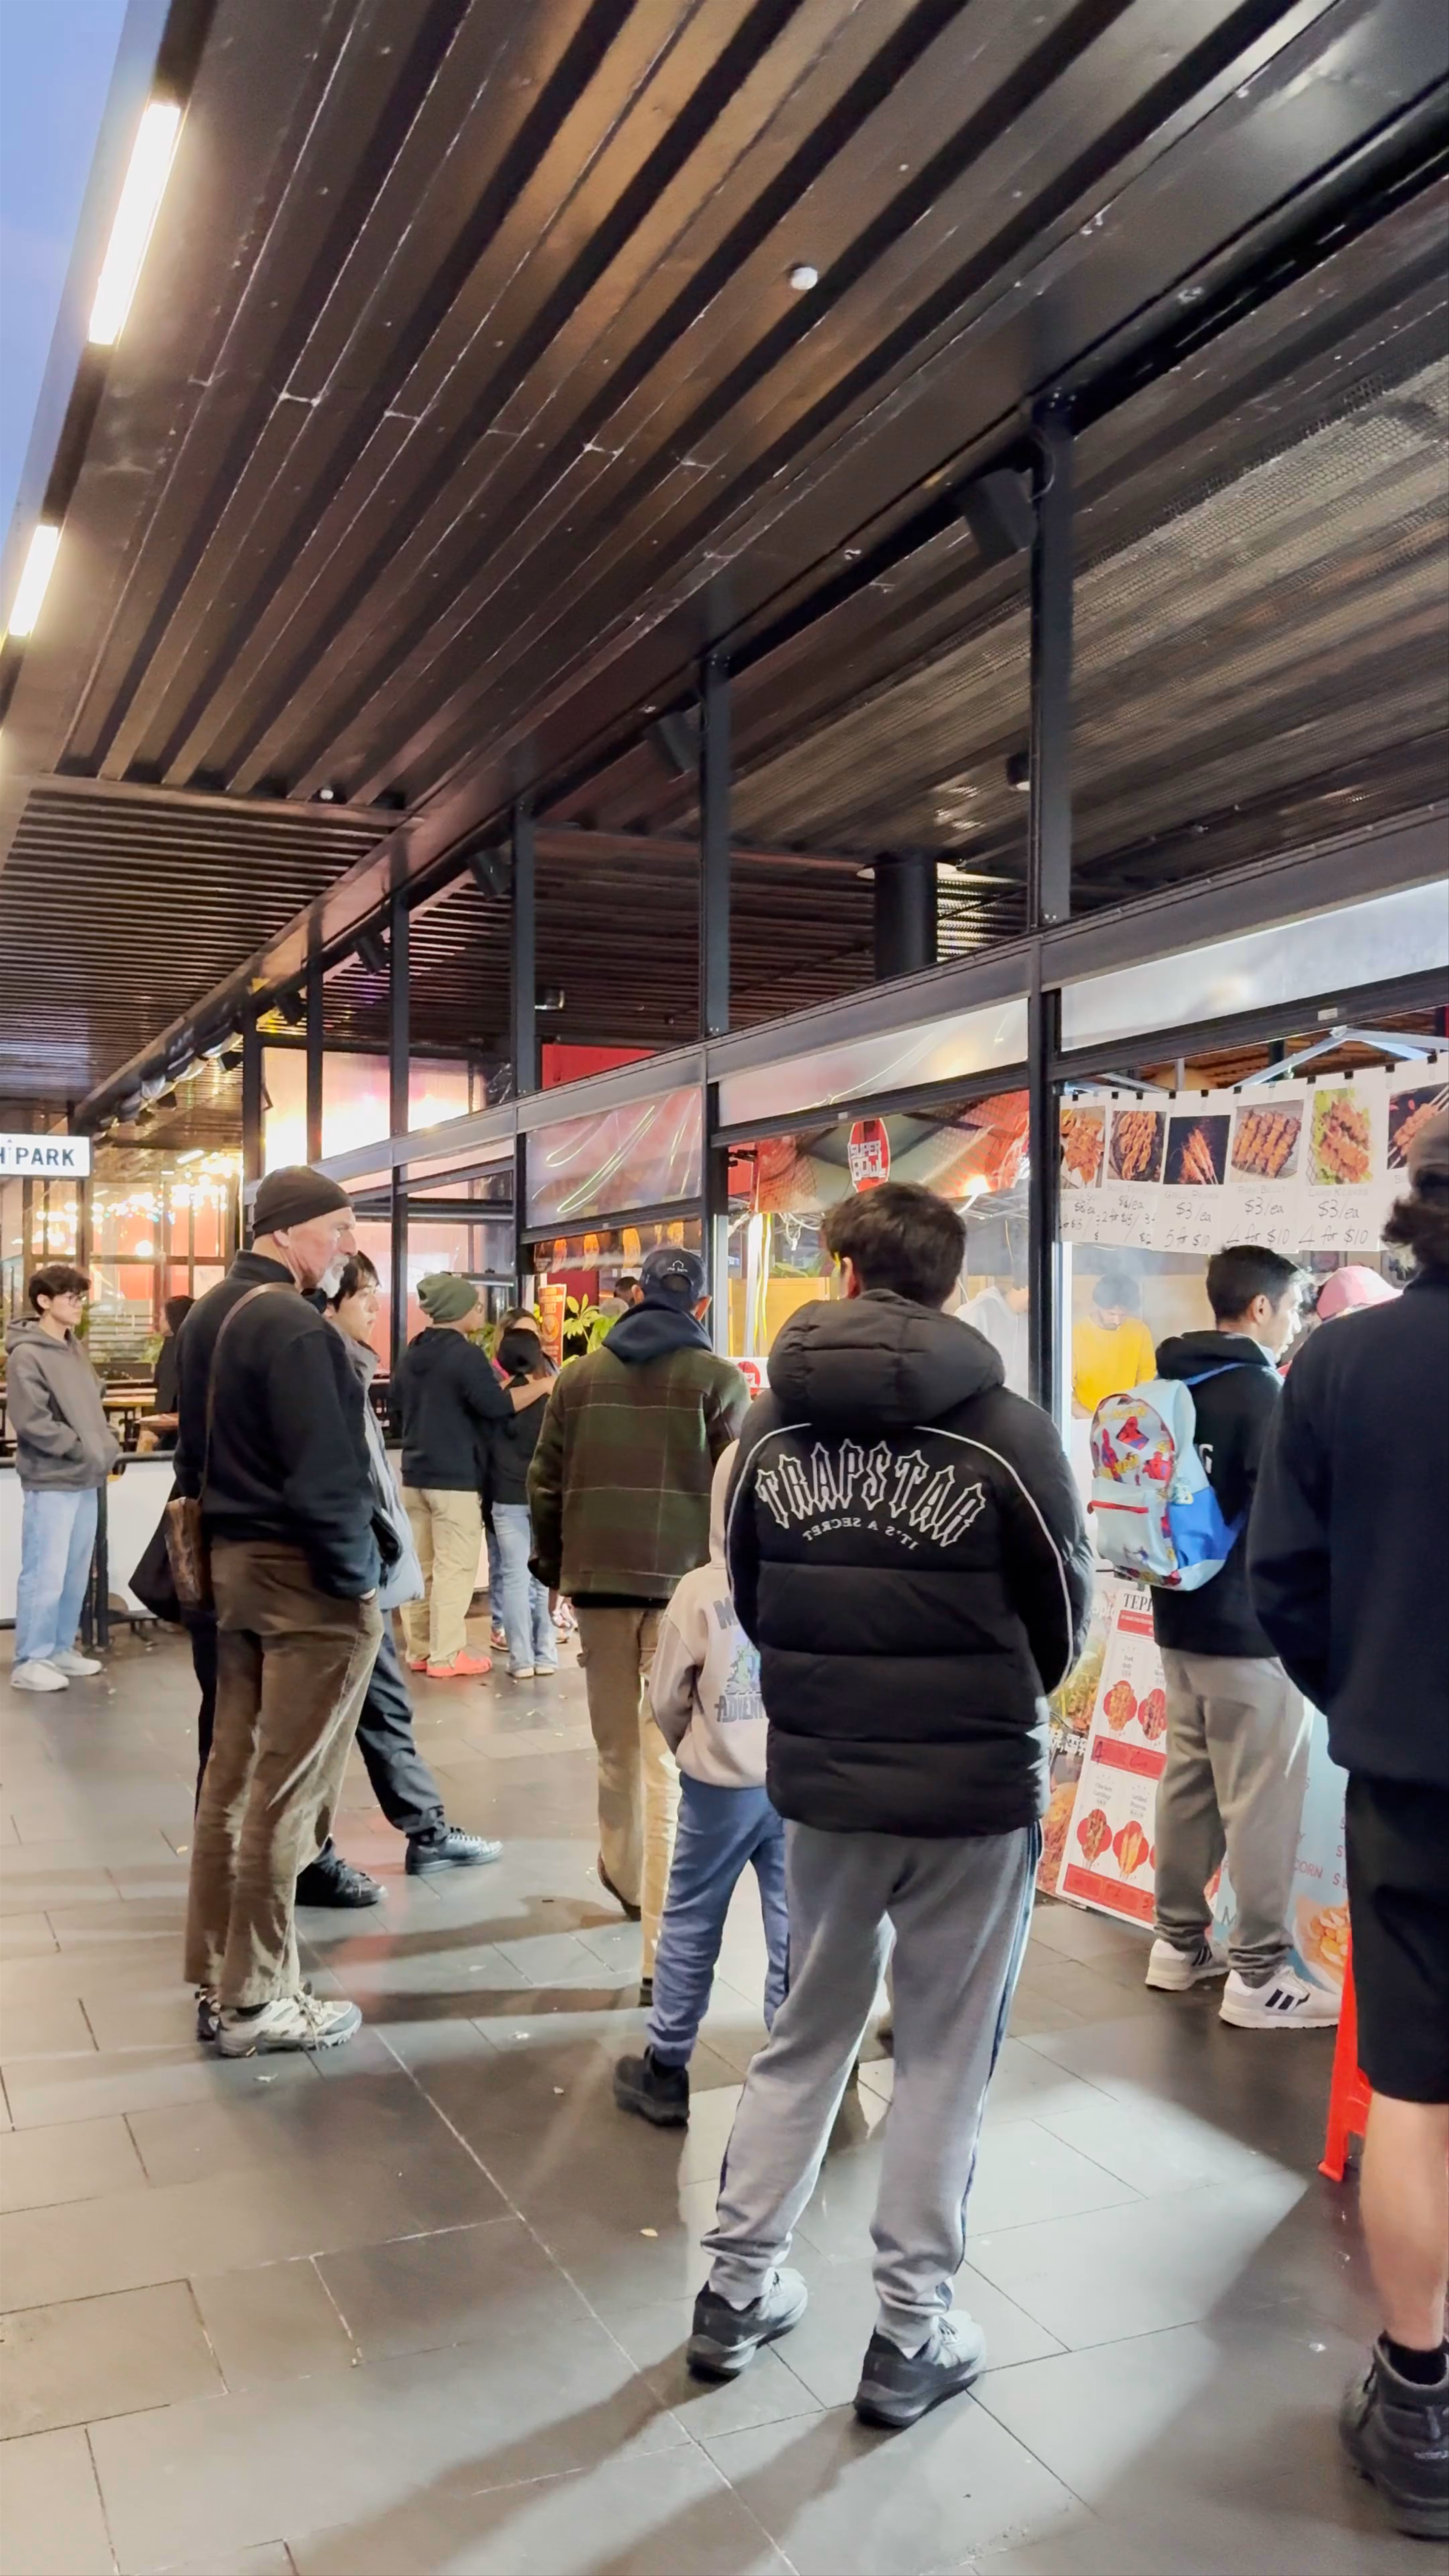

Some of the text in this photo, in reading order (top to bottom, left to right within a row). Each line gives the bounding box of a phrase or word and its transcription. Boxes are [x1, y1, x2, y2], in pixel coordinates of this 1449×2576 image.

[16, 1147, 75, 1167] PARK
[848, 1141, 881, 1159] SUPER
[852, 1155, 886, 1180] BOWL
[1244, 1196, 1284, 1215] $3/ea
[1318, 1198, 1359, 1220] $3/ea
[1267, 1225, 1290, 1246] $10
[1343, 1225, 1369, 1247] $10
[755, 1438, 986, 1547] TRAPSTAR
